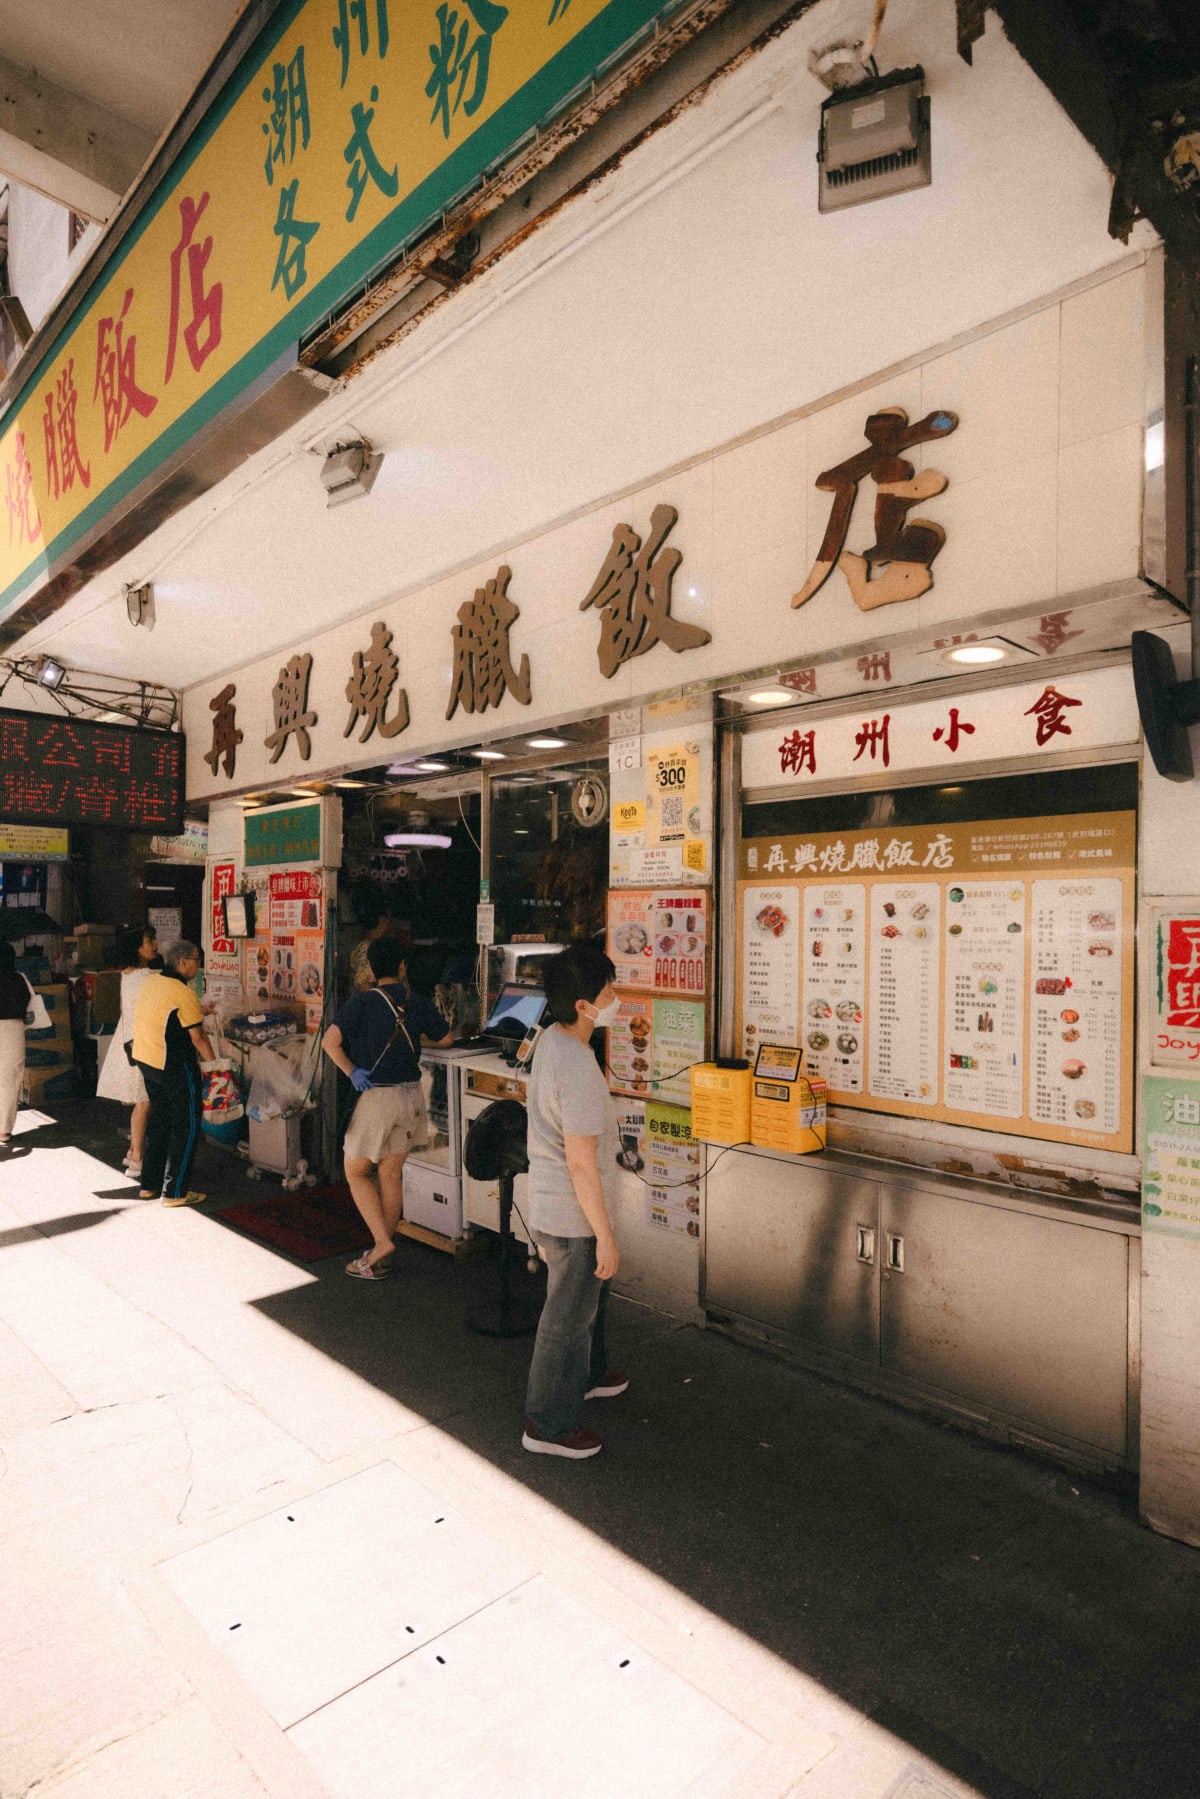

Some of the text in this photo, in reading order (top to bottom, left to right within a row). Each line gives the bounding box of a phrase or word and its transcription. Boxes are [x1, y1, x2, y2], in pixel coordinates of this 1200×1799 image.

[270, 0, 571, 301] 各式粉
[203, 407, 960, 779] 再興燒臘飯店
[780, 685, 1083, 776] 潮州小食
[763, 833, 955, 874] 再興燒臘飯店
[650, 1119, 699, 1143] 自家製涼
